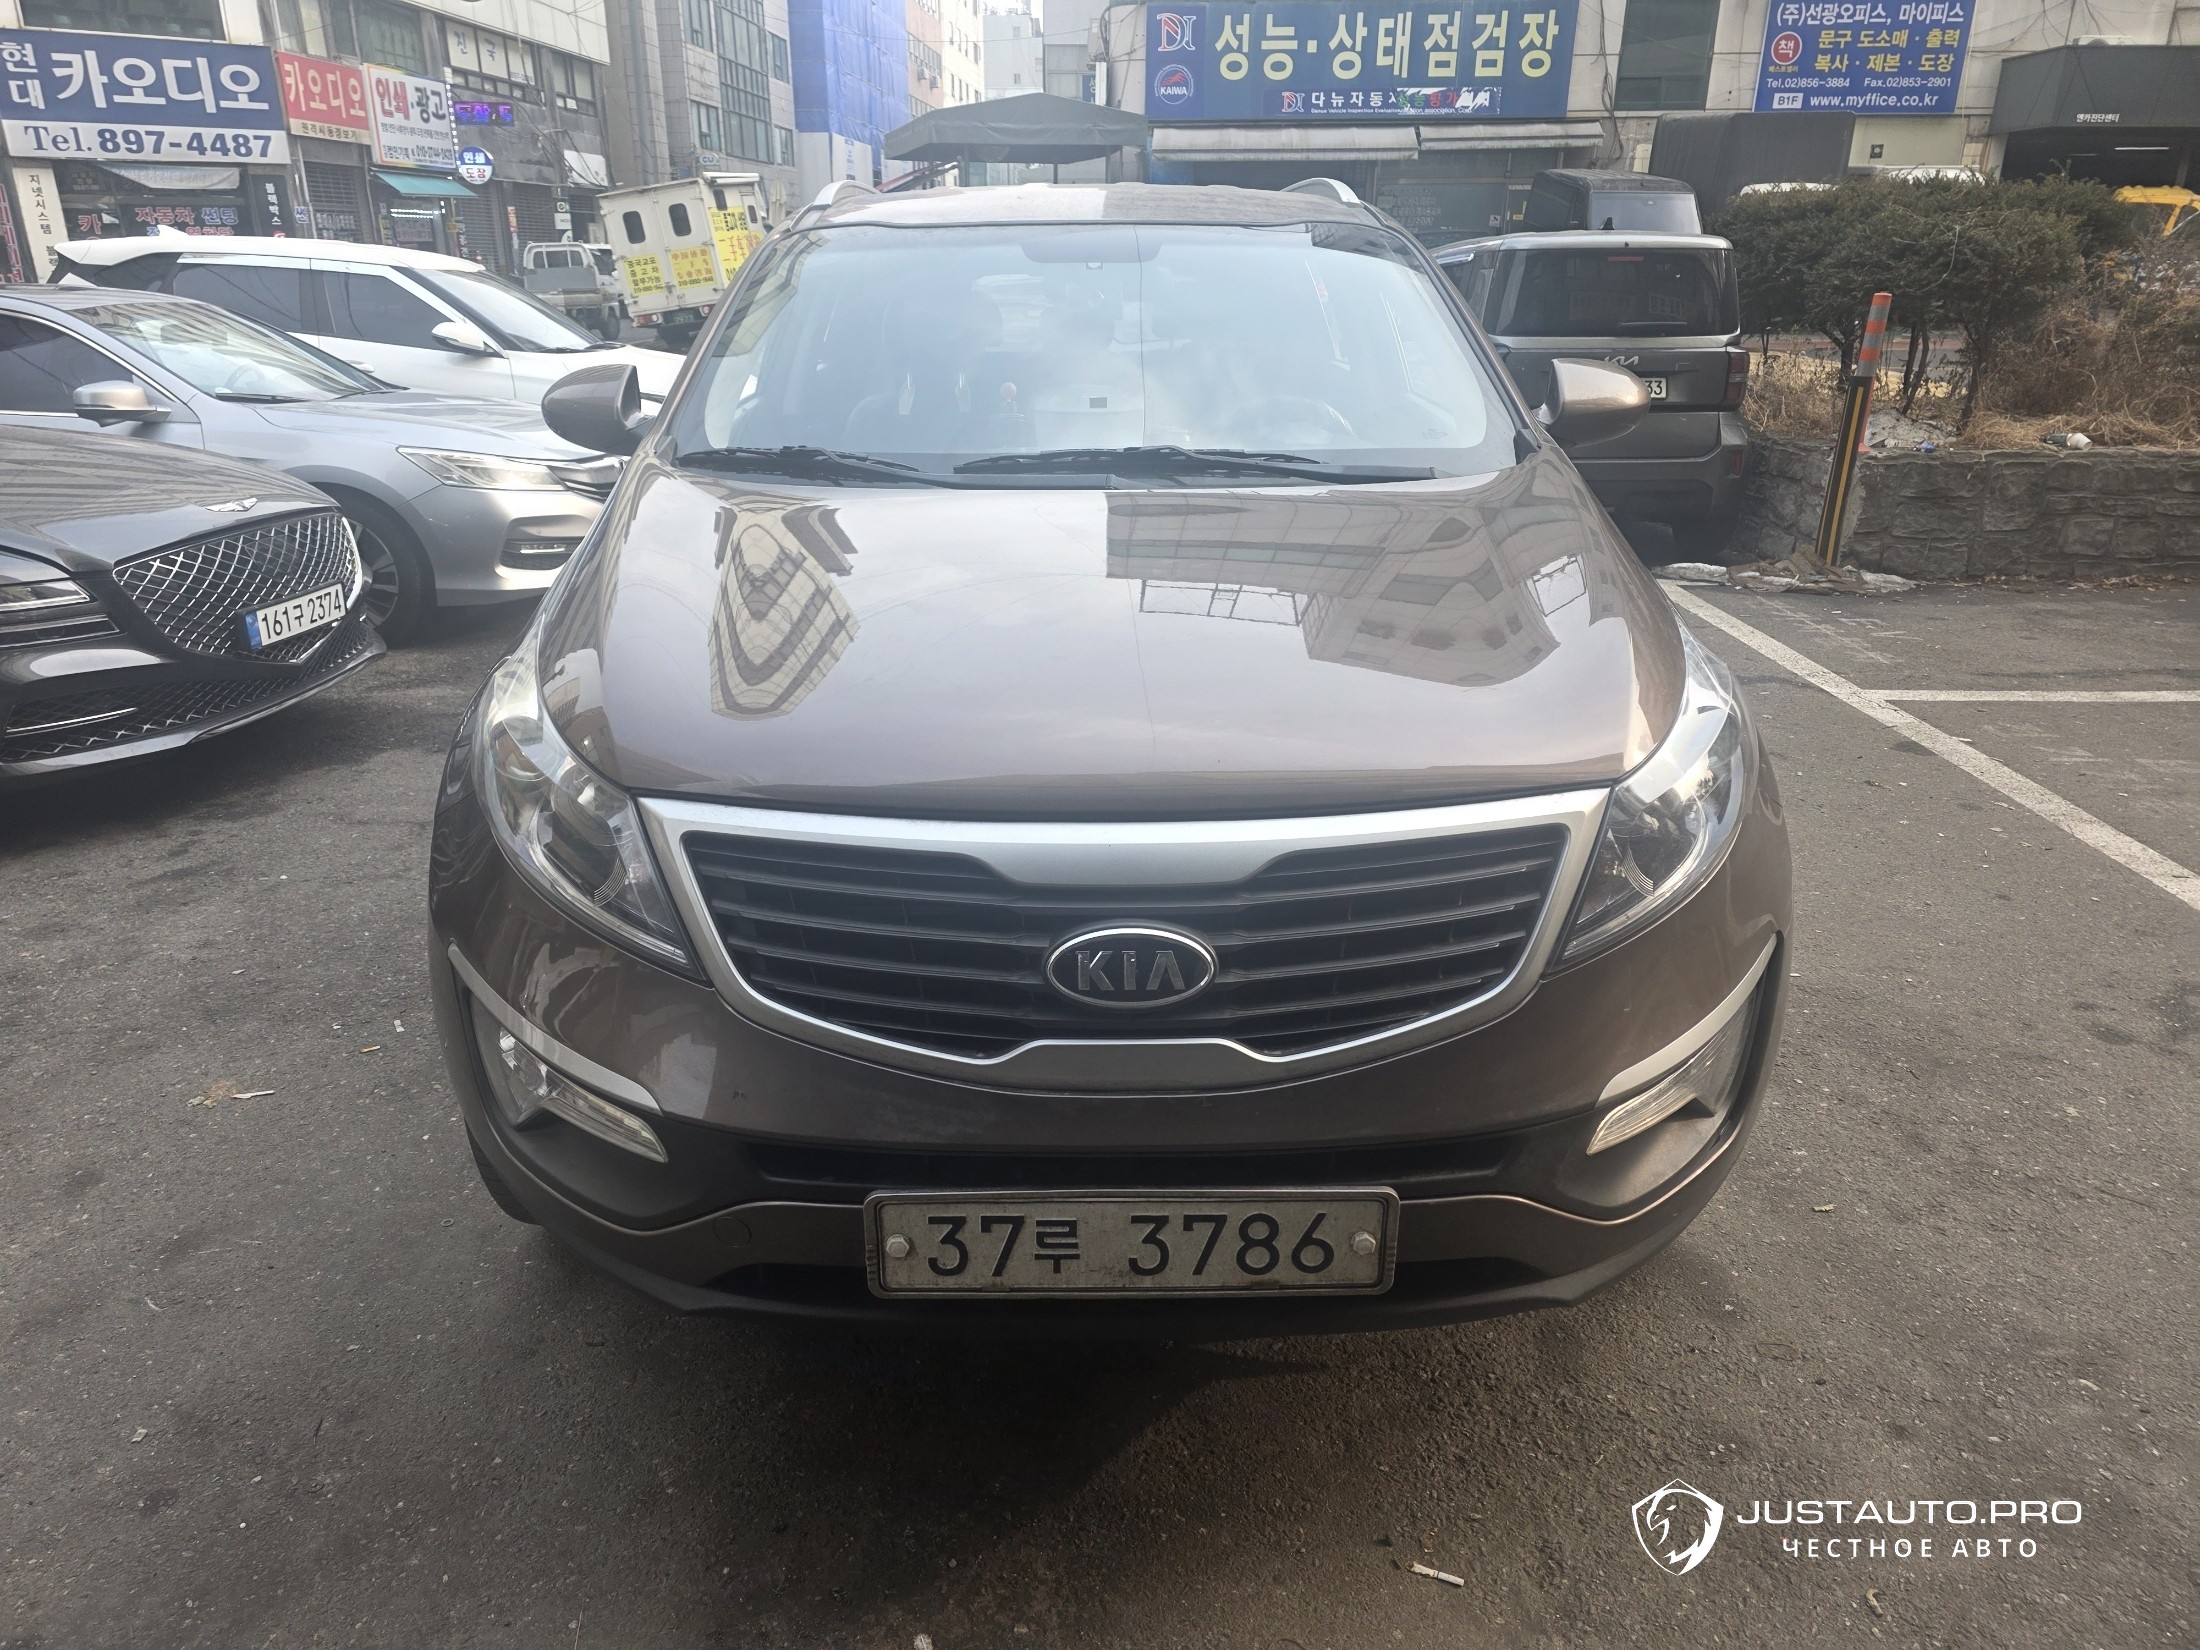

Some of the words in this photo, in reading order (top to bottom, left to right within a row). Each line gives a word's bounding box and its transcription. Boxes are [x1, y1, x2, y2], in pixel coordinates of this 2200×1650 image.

[1777, 3, 1891, 26] (주)선광오피스,
[1899, 2, 1964, 25] 마이피스
[1818, 29, 1852, 48] 문구
[1857, 29, 1907, 48] 도소매
[1926, 28, 1960, 48] 출력
[1778, 40, 1794, 58] 책
[1768, 65, 1799, 73] 베스트셀러
[1814, 54, 1849, 73] 복사
[1866, 54, 1900, 73] 제본
[1918, 53, 1954, 73] 도장
[51, 50, 270, 113] 카오디오
[283, 61, 366, 118] 카오디오
[1767, 77, 1850, 89] Tel.02)856-3884
[1864, 77, 1951, 89] Fax.02)853-2901
[1777, 95, 1799, 105] B1F
[1810, 92, 1939, 110] www.myffice.co.kr
[2076, 113, 2120, 123] 엔카진단센터
[98, 128, 272, 158] 897-4487
[463, 152, 485, 163] 인쇄
[702, 154, 716, 164] CU
[265, 182, 282, 225] 블랙박스
[135, 207, 195, 225] 자동차
[201, 207, 239, 226] 썬팅
[308, 589, 342, 624] 2374
[1075, 950, 1186, 991] KIA
[927, 1212, 1081, 1277] 37루
[1127, 1212, 1335, 1276] 3786
